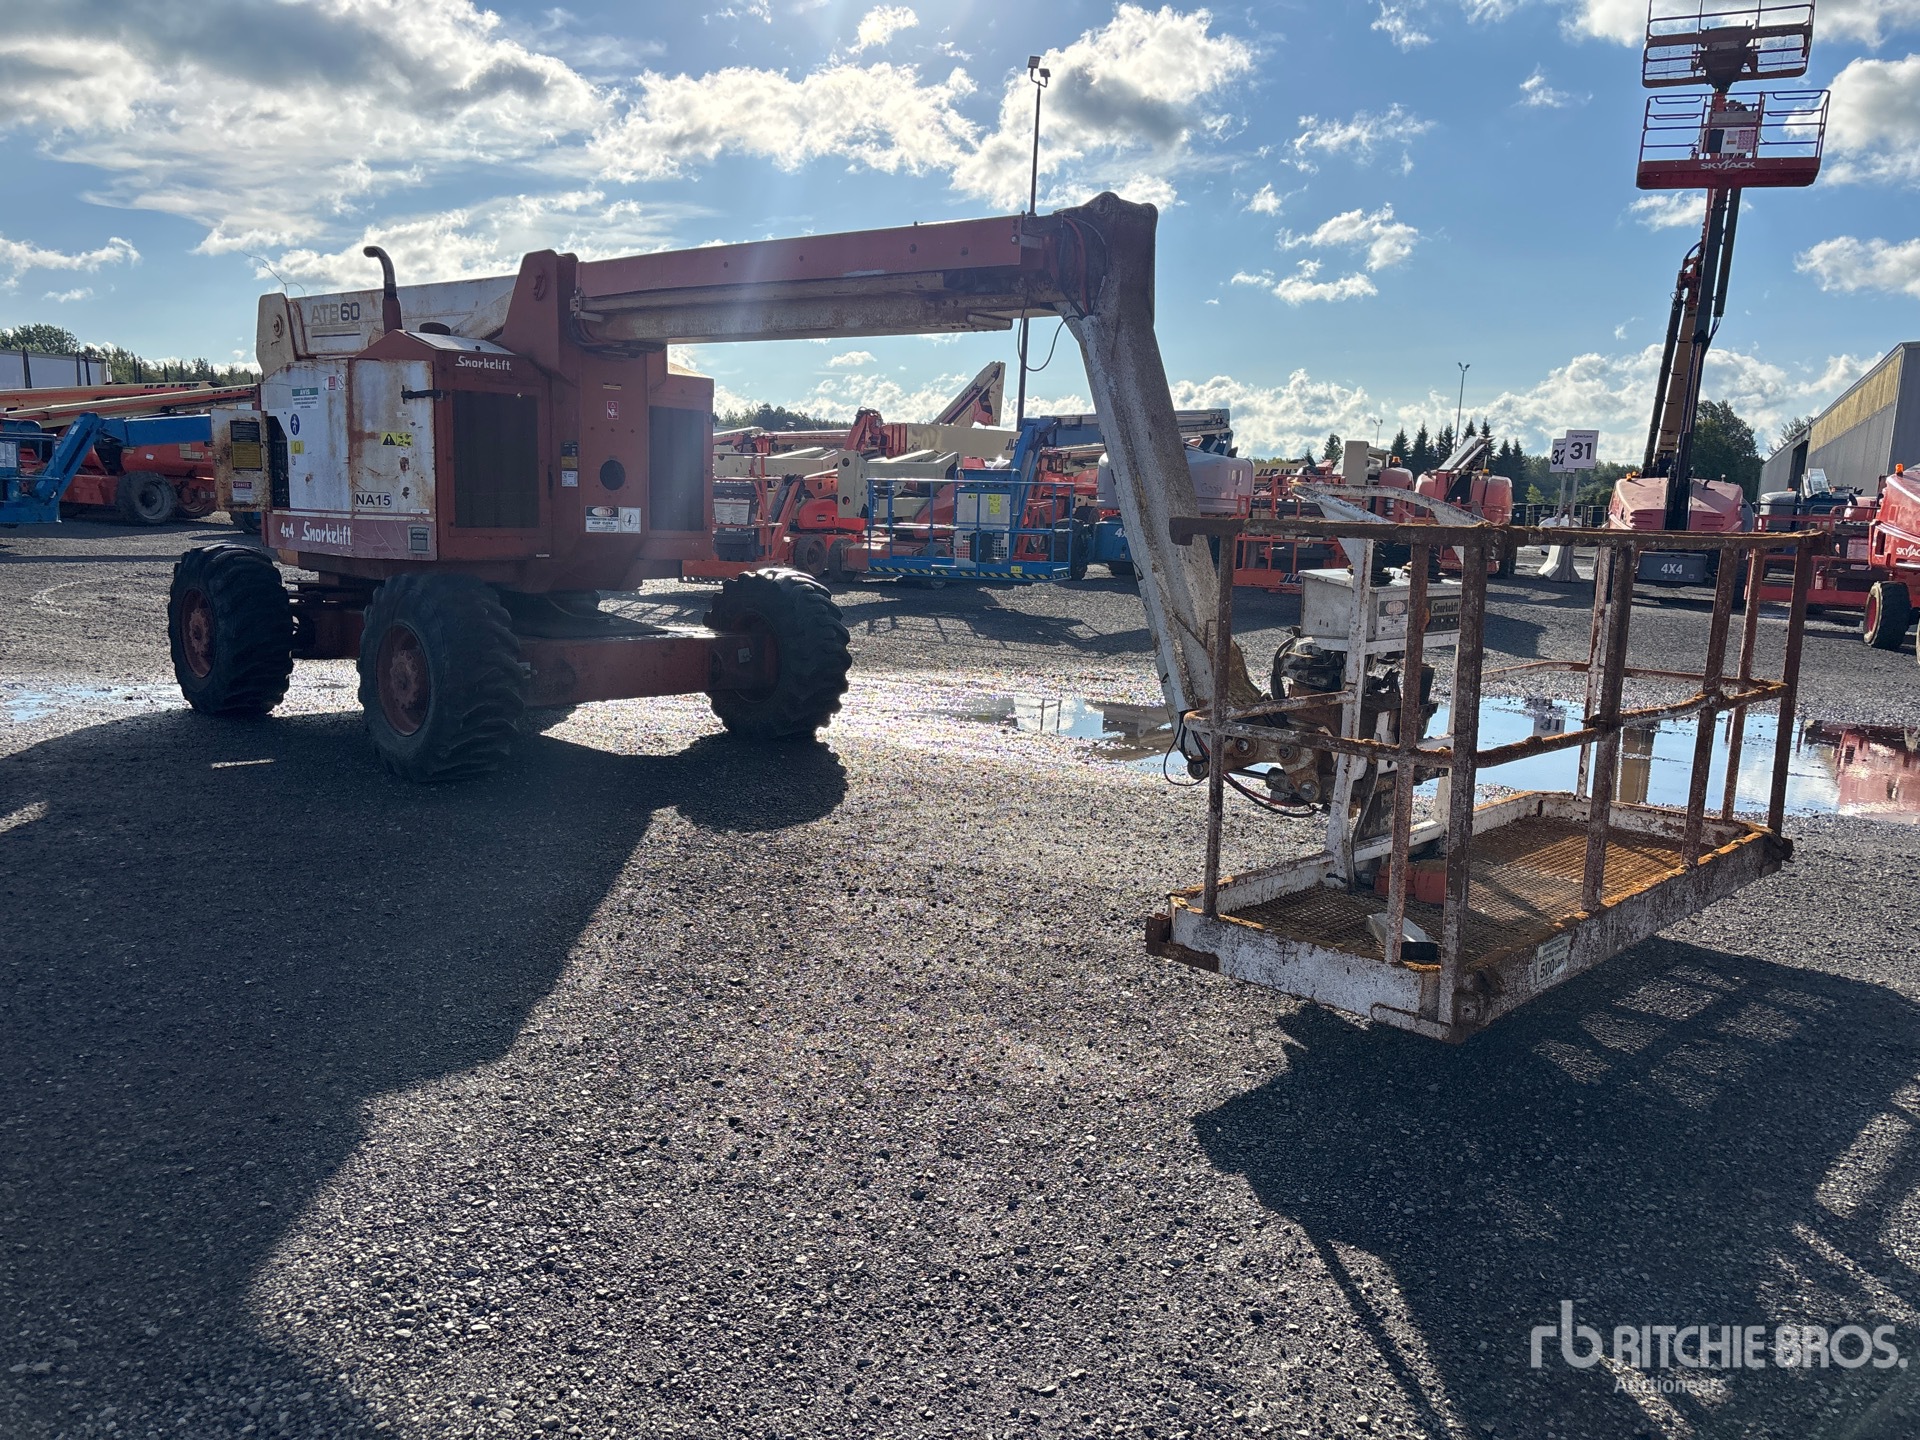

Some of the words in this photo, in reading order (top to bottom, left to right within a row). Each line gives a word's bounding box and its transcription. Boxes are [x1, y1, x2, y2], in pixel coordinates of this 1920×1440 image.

[1700, 159, 1756, 170] SKYJACK
[311, 301, 361, 323] ATB60
[455, 355, 512, 371] Snorkelift
[1569, 441, 1593, 460] 31
[354, 493, 391, 506] NA15
[280, 522, 295, 538] 4x4
[301, 520, 352, 546] Snorkelift
[1660, 563, 1683, 575] 4X4
[1540, 958, 1555, 978] 500
